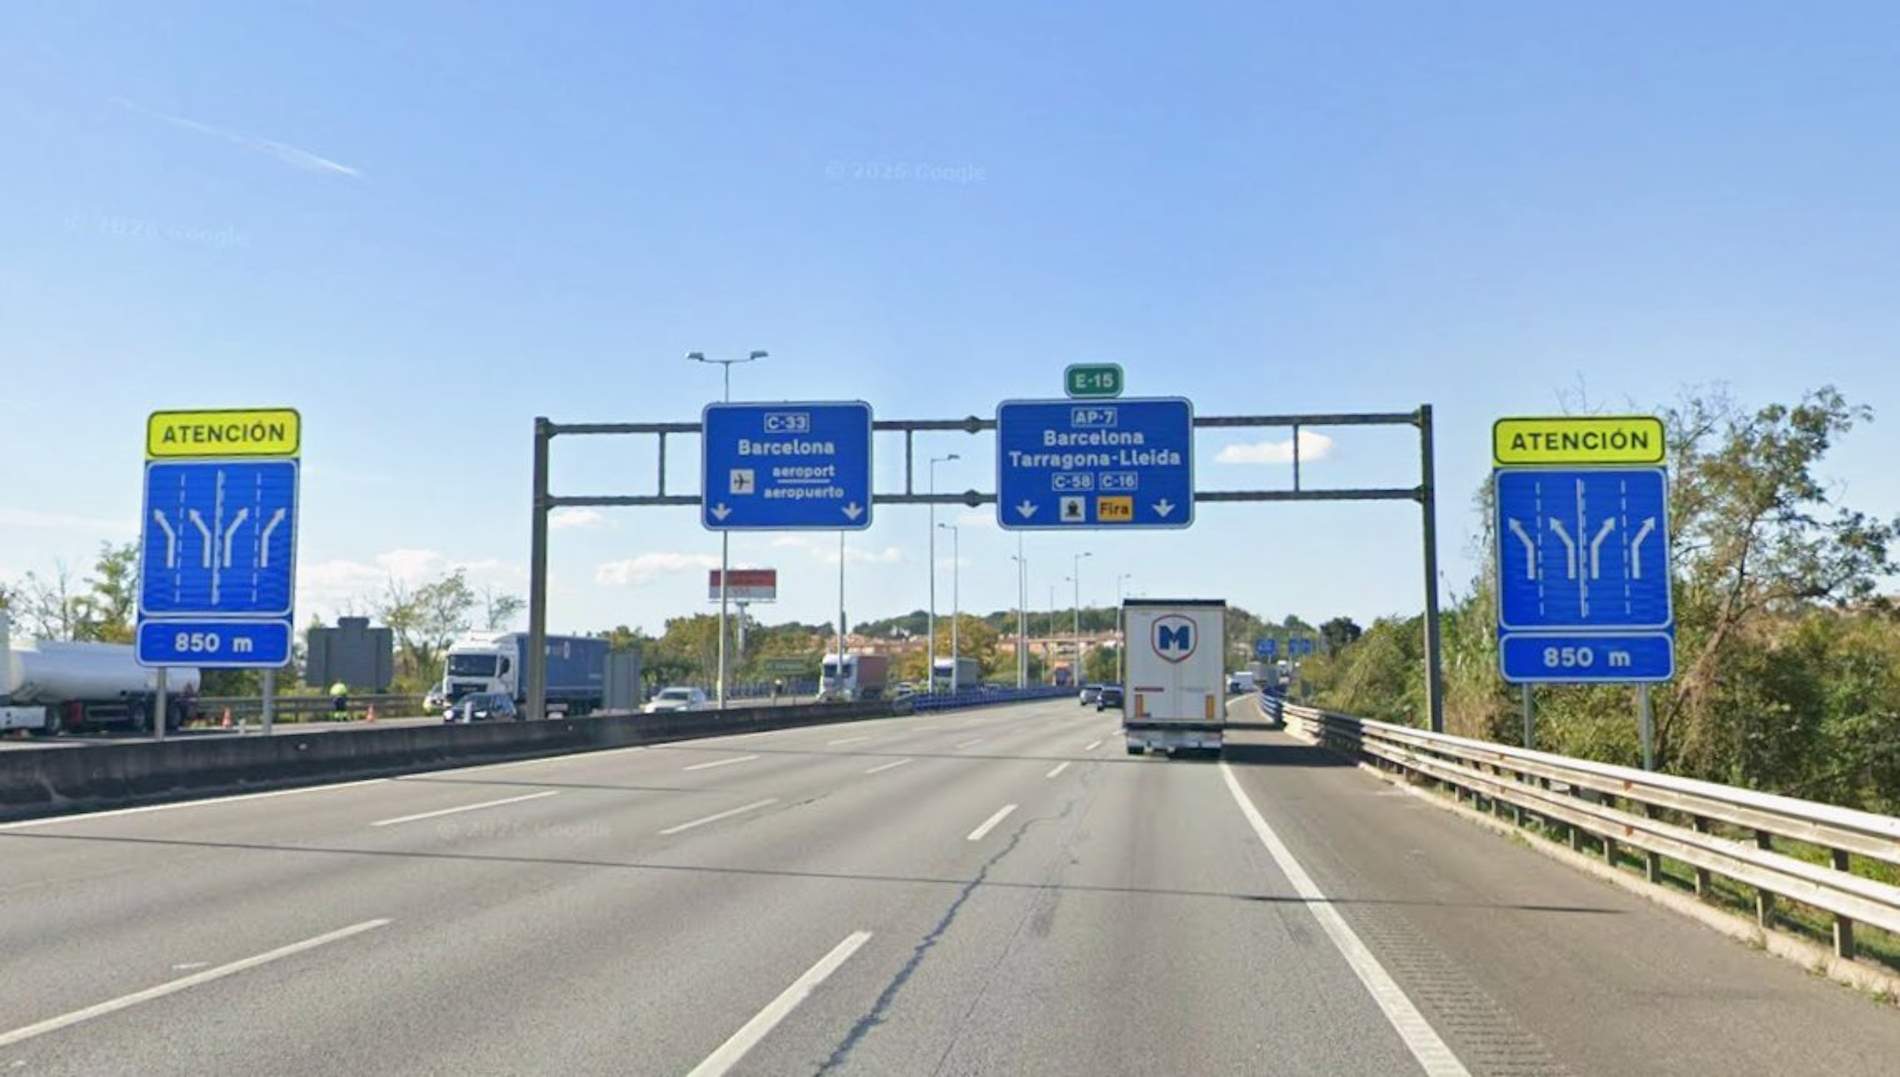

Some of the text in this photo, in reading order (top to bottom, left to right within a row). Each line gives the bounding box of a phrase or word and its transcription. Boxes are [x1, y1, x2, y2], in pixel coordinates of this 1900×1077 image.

[1075, 373, 1114, 388] E-15
[767, 416, 806, 429] C-33
[1075, 411, 1114, 424] AP-7
[162, 420, 285, 443] ATENCIÓN
[1043, 429, 1145, 446] Barcelona
[1510, 428, 1648, 451] ATENCIÓN
[738, 438, 835, 455] Barcelona
[1008, 449, 1181, 470] Tarragona-Lleida
[772, 465, 836, 479] aeroport
[1054, 474, 1136, 488] C-58 C-16
[764, 485, 845, 500] aeropuerto
[1099, 502, 1130, 516] Fira
[175, 632, 253, 653] 850 m
[1159, 625, 1190, 649] M
[1543, 647, 1631, 668] 850 m
